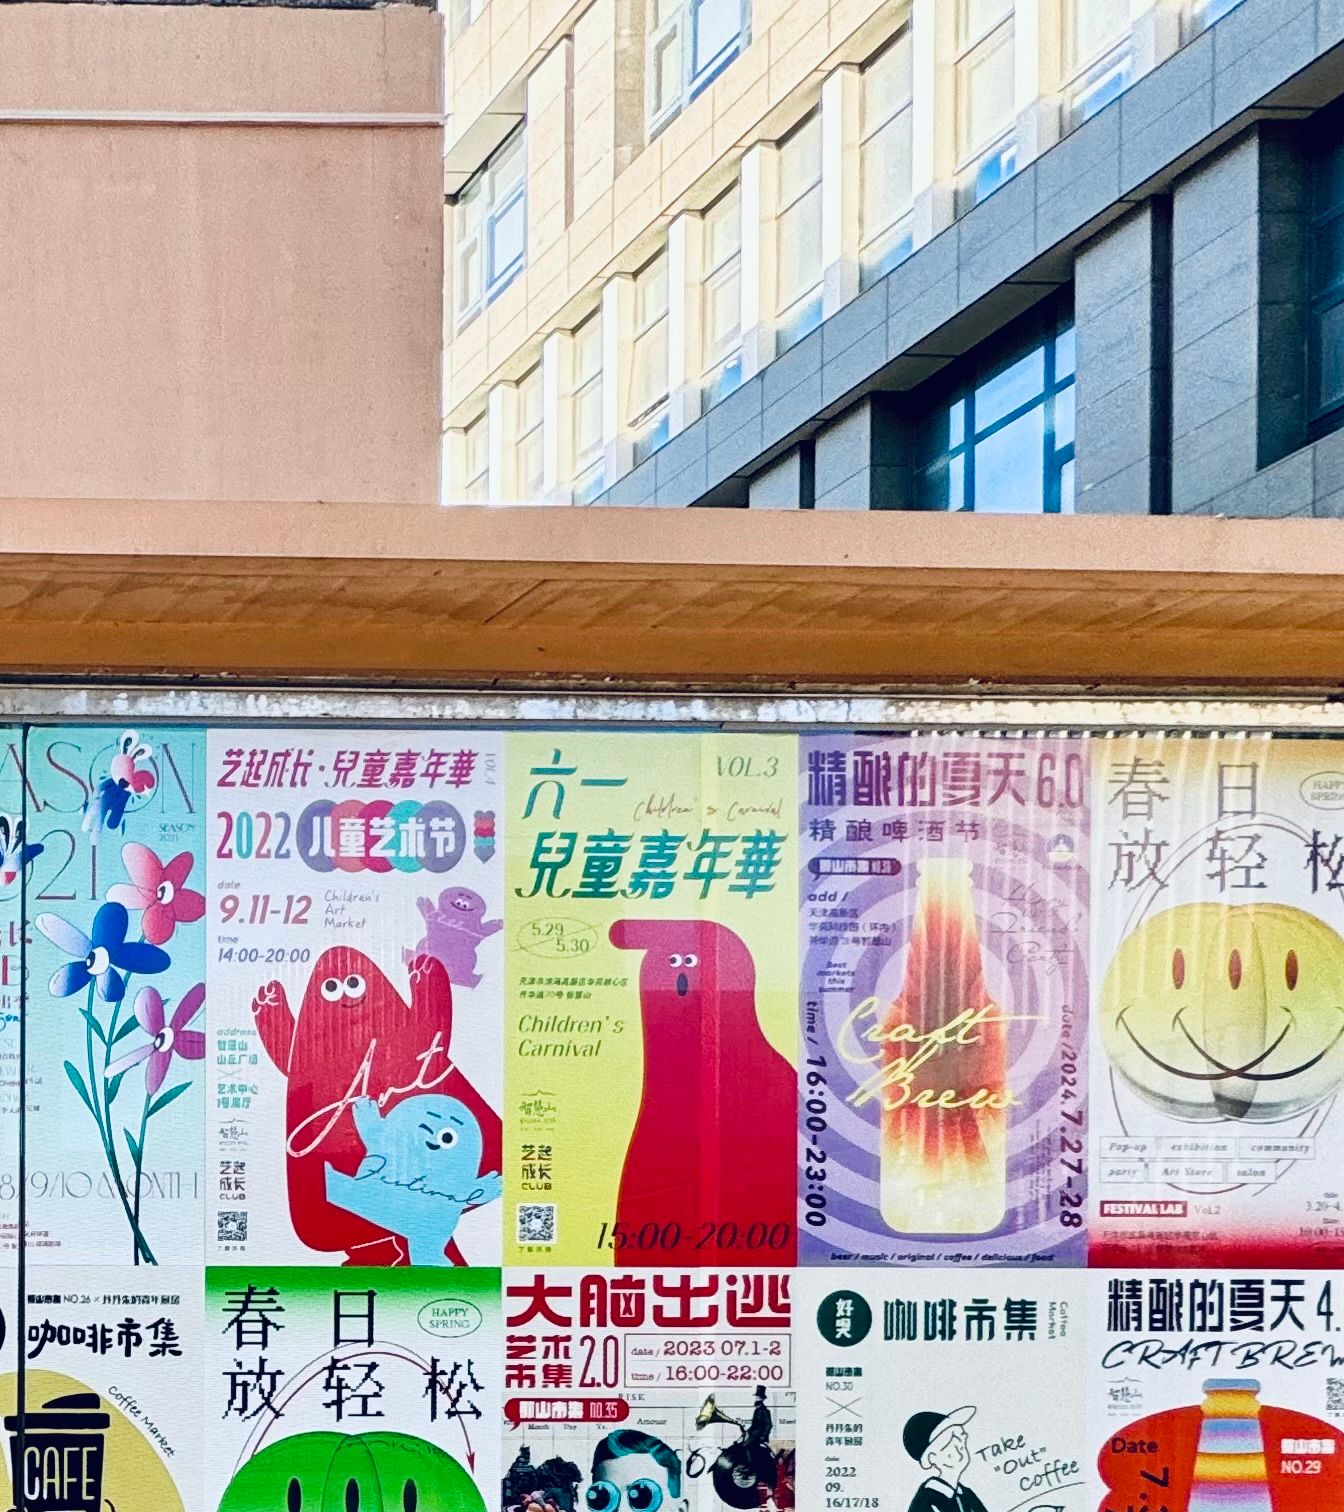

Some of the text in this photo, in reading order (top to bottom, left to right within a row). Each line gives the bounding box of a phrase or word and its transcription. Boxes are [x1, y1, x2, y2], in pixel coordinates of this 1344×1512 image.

[716, 755, 779, 778] VOL.3
[217, 811, 457, 859] 2022 儿童艺术节
[809, 819, 980, 843] 精酿啤酒节
[515, 827, 788, 900] 兒童嘉年華
[219, 894, 312, 926] 9.11-12
[325, 917, 367, 929] Market
[218, 946, 310, 964] 14:00-20:00
[518, 1039, 603, 1058] Carnival
[1104, 1204, 1184, 1215] FESTIVAL LAB
[597, 1221, 791, 1251] 15:00-20:00
[506, 1274, 791, 1328] 大脑出逃
[429, 1319, 470, 1330] SPRING
[431, 1307, 469, 1319] HAPPY
[883, 1298, 1038, 1341] 咖啡市集
[28, 1318, 183, 1358] 咖啡市集
[579, 1335, 619, 1388] 2.0
[666, 1365, 783, 1381] 16:00-22:00
[222, 1357, 484, 1421] 放轻松
[825, 1381, 853, 1391] NO.30
[976, 1435, 1026, 1462] Take
[1112, 1437, 1159, 1455] Date
[24, 1446, 97, 1501] CAFE
[825, 1467, 857, 1478] 2022
[1281, 1461, 1321, 1475] NO.29
[825, 1497, 879, 1509] 16/17/18
